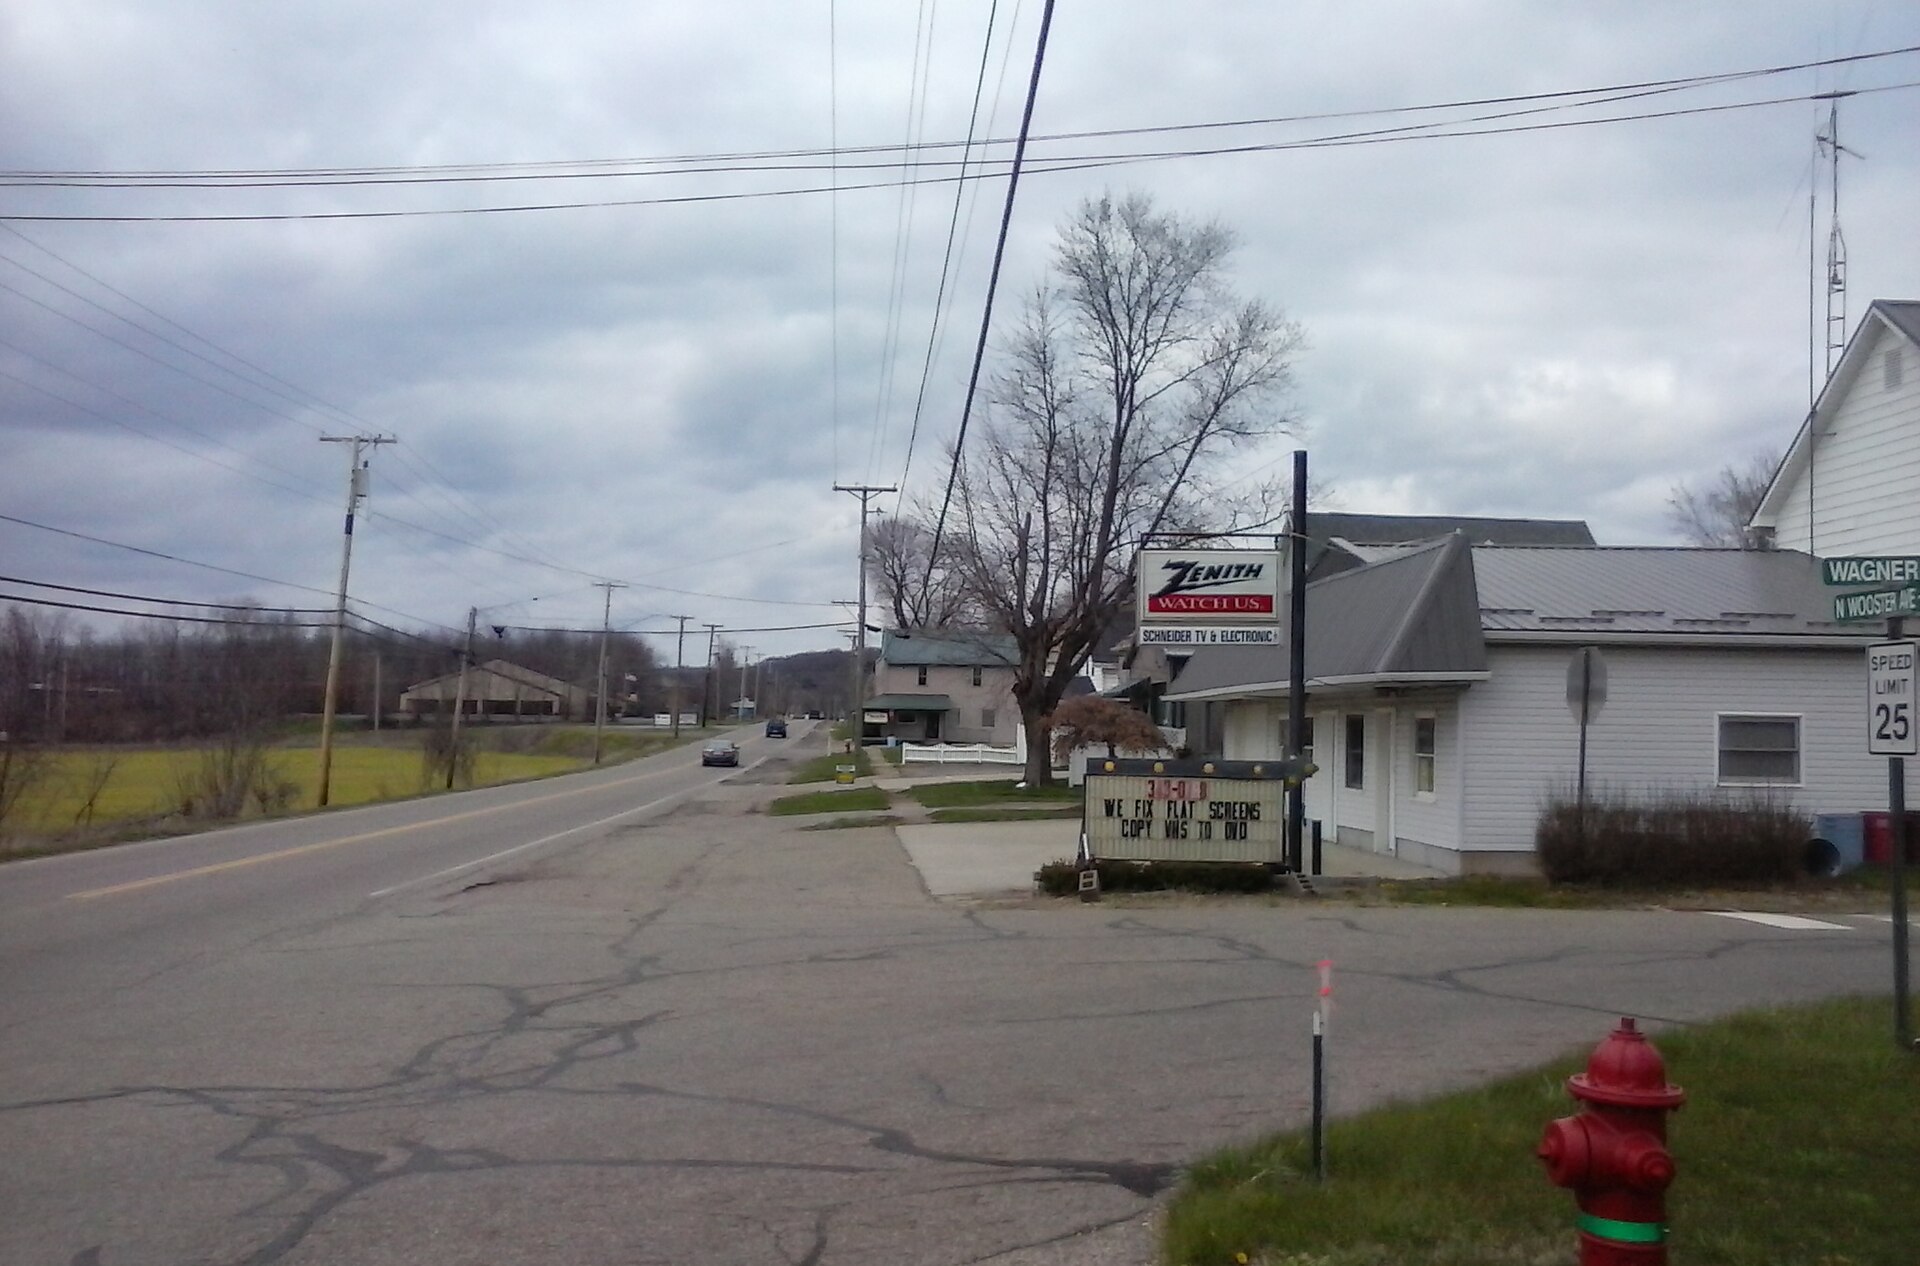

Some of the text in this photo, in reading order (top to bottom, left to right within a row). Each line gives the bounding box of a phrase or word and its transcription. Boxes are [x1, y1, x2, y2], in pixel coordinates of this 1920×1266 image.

[1150, 559, 1264, 596] ZENITH
[1828, 559, 1919, 582] WAGNER
[1158, 597, 1228, 610] WATCH
[1835, 598, 1845, 619] N
[1847, 592, 1897, 616] WOOSTER
[1143, 630, 1192, 643] SCHNEIDER
[1195, 630, 1207, 643] TV
[1210, 630, 1217, 643] &
[1871, 653, 1912, 671] SPEED
[1875, 679, 1909, 695] LIMIT
[1875, 703, 1909, 740] 25
[1104, 799, 1261, 821] WE FIX FLAT SCREENS
[1121, 819, 1248, 840] COPY VHS TO DVD
